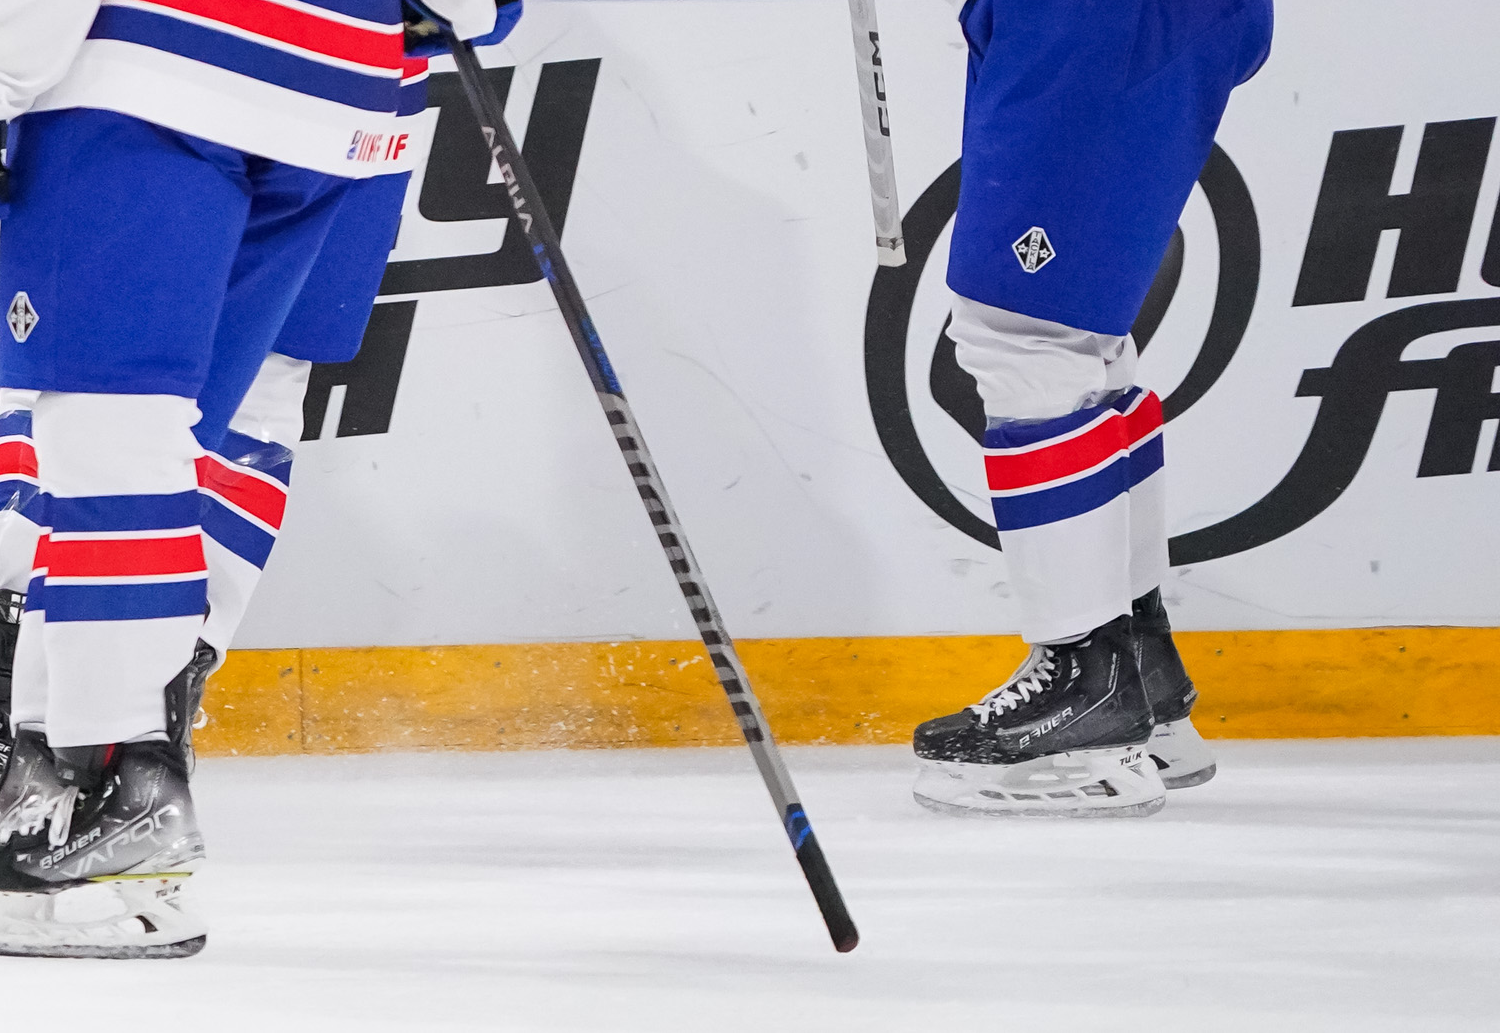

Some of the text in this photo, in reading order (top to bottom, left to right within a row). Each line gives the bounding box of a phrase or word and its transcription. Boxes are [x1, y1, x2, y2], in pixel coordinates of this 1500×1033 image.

[1025, 230, 1043, 271] TACKLA
[1019, 706, 1074, 750] BAUER
[38, 826, 102, 870] BAUER
